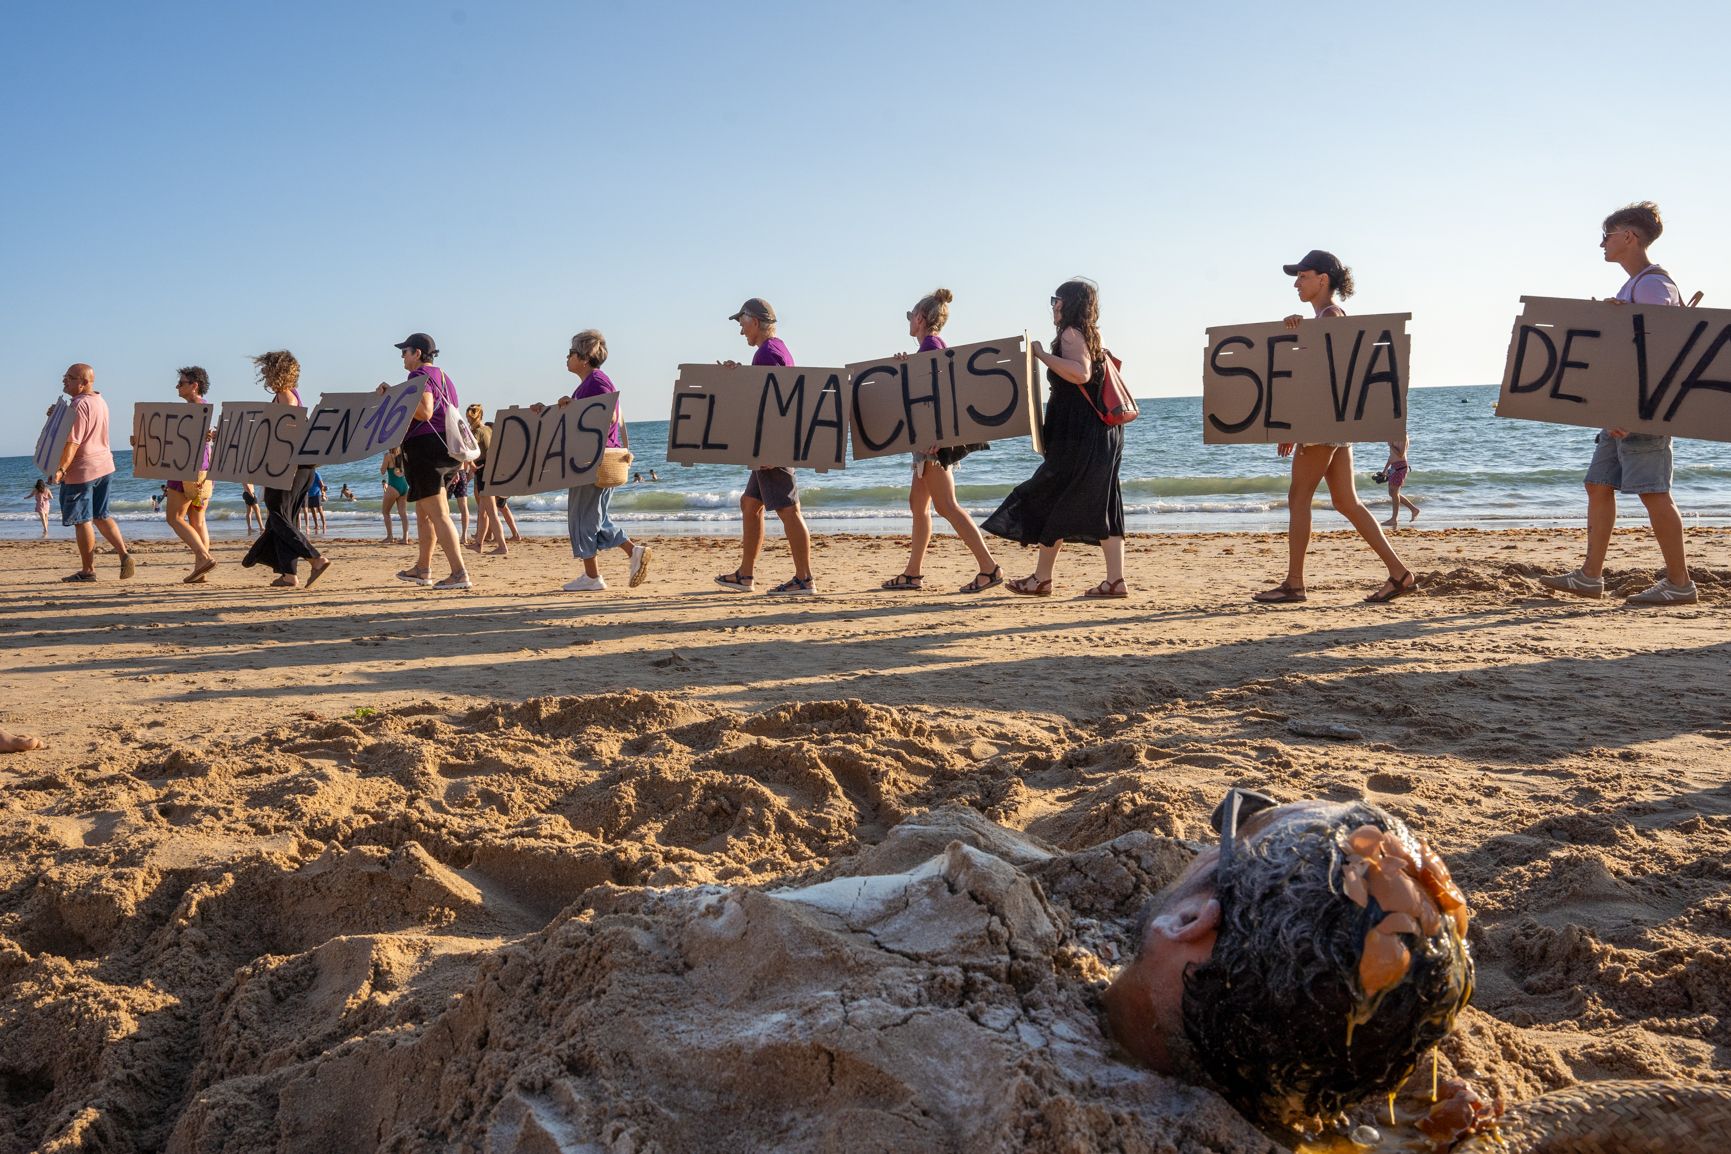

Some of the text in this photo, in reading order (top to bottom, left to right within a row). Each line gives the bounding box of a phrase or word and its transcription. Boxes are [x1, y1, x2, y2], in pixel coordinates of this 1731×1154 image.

[1208, 329, 1402, 434] SE VA
[1509, 324, 1600, 404] DE
[209, 411, 296, 478] NATOS
[298, 385, 418, 456] EN 16
[490, 402, 606, 488] DÍAS
[671, 372, 844, 464] EL MA
